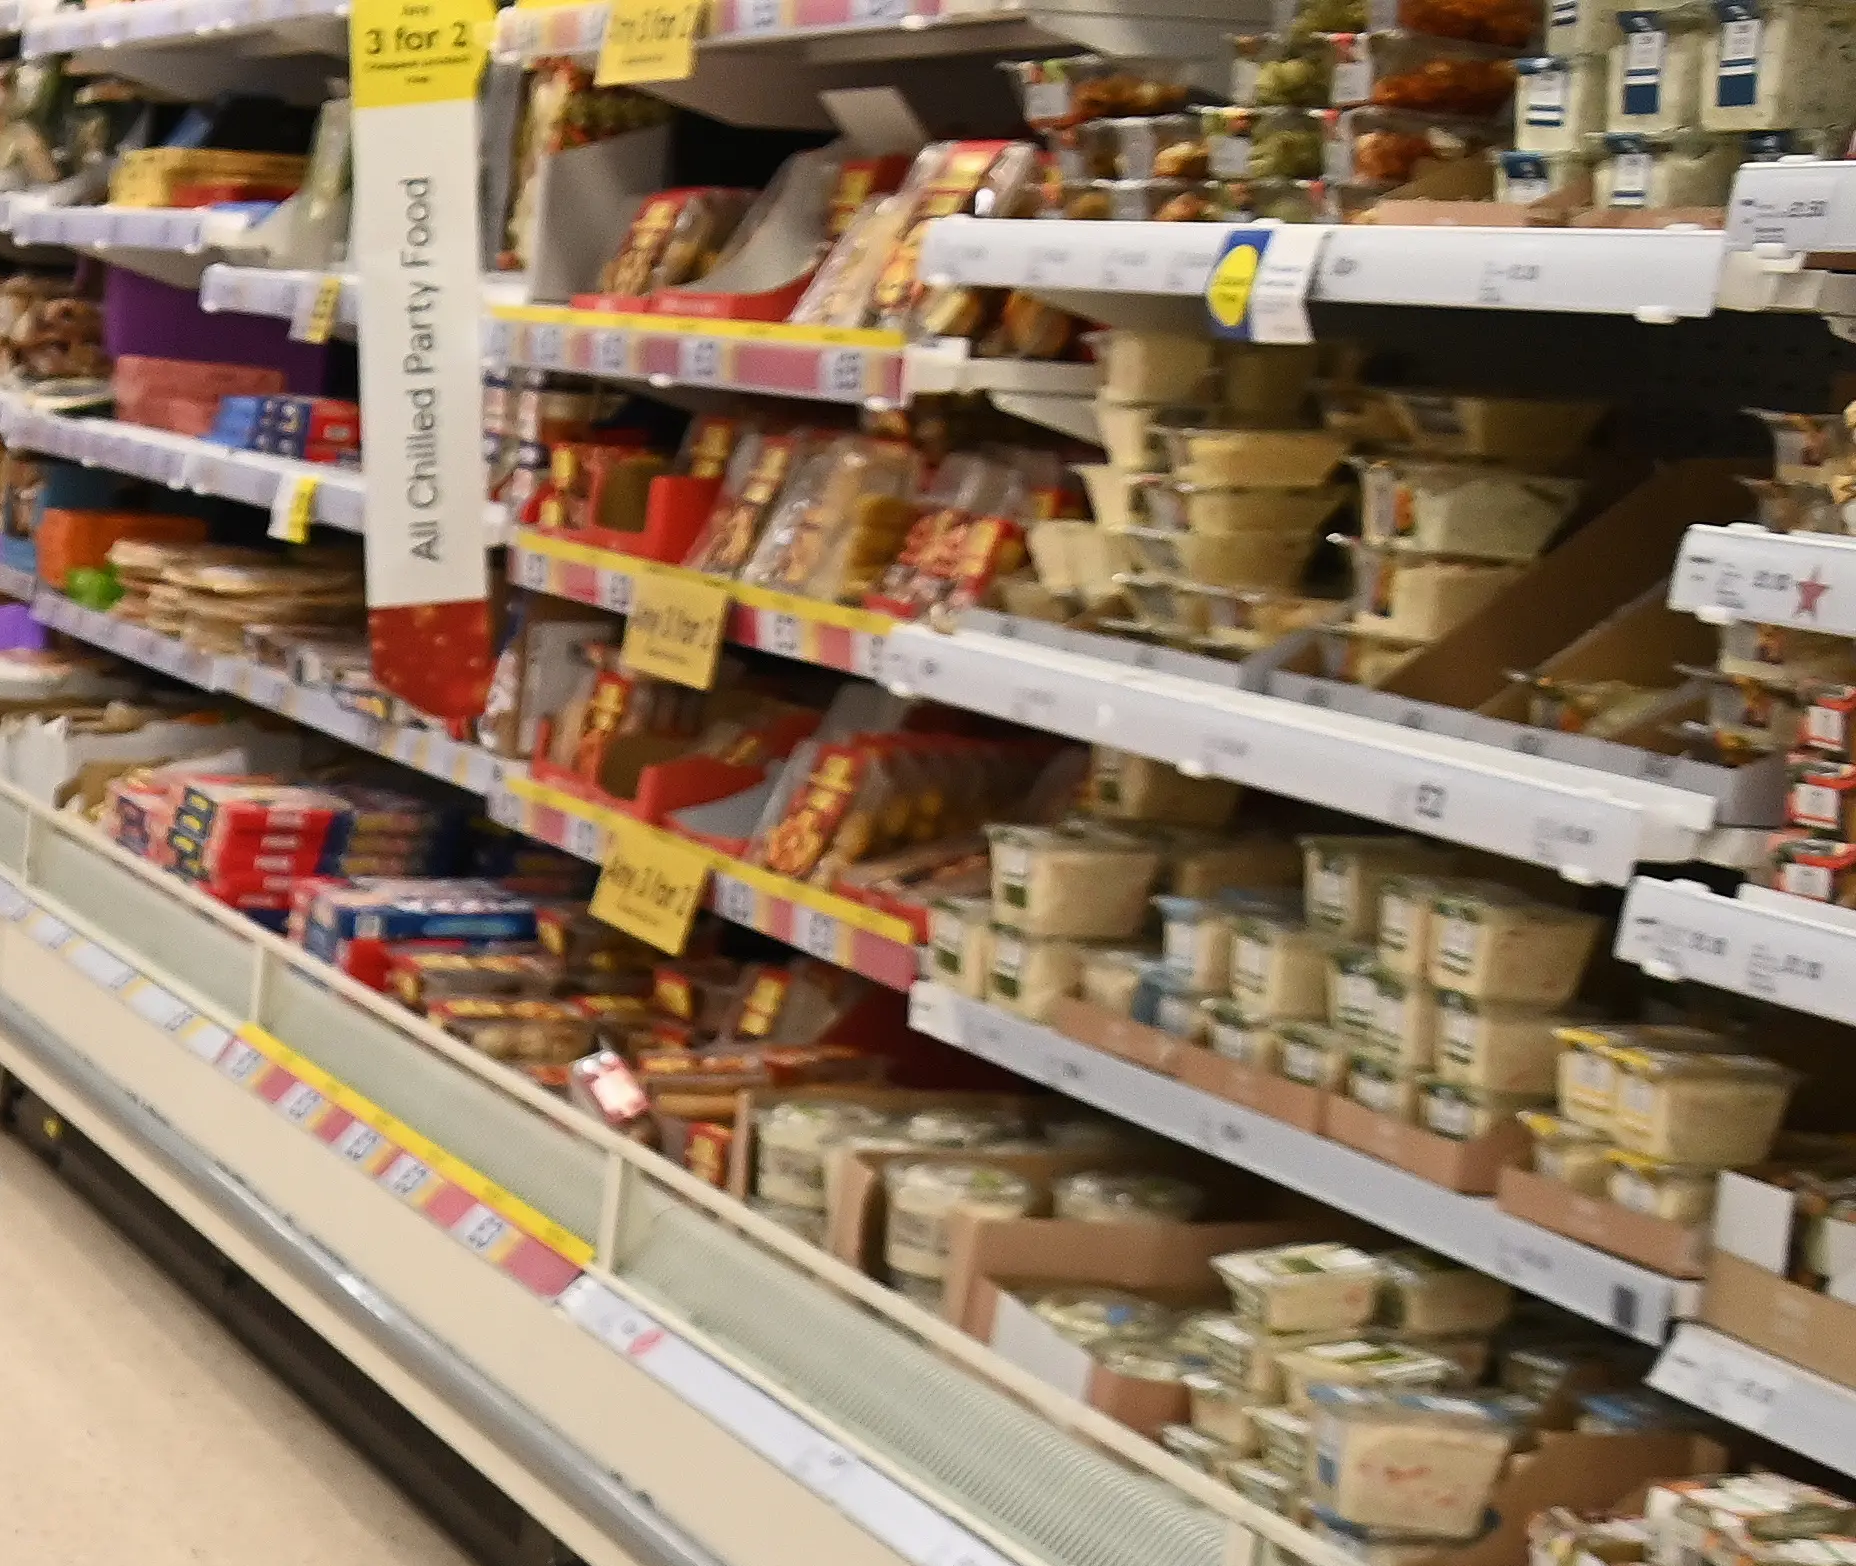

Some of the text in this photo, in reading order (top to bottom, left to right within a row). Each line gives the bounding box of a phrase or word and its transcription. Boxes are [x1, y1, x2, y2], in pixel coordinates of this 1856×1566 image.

[365, 22, 469, 55] 3 for 2
[399, 175, 441, 562] All Chilled Party Food
